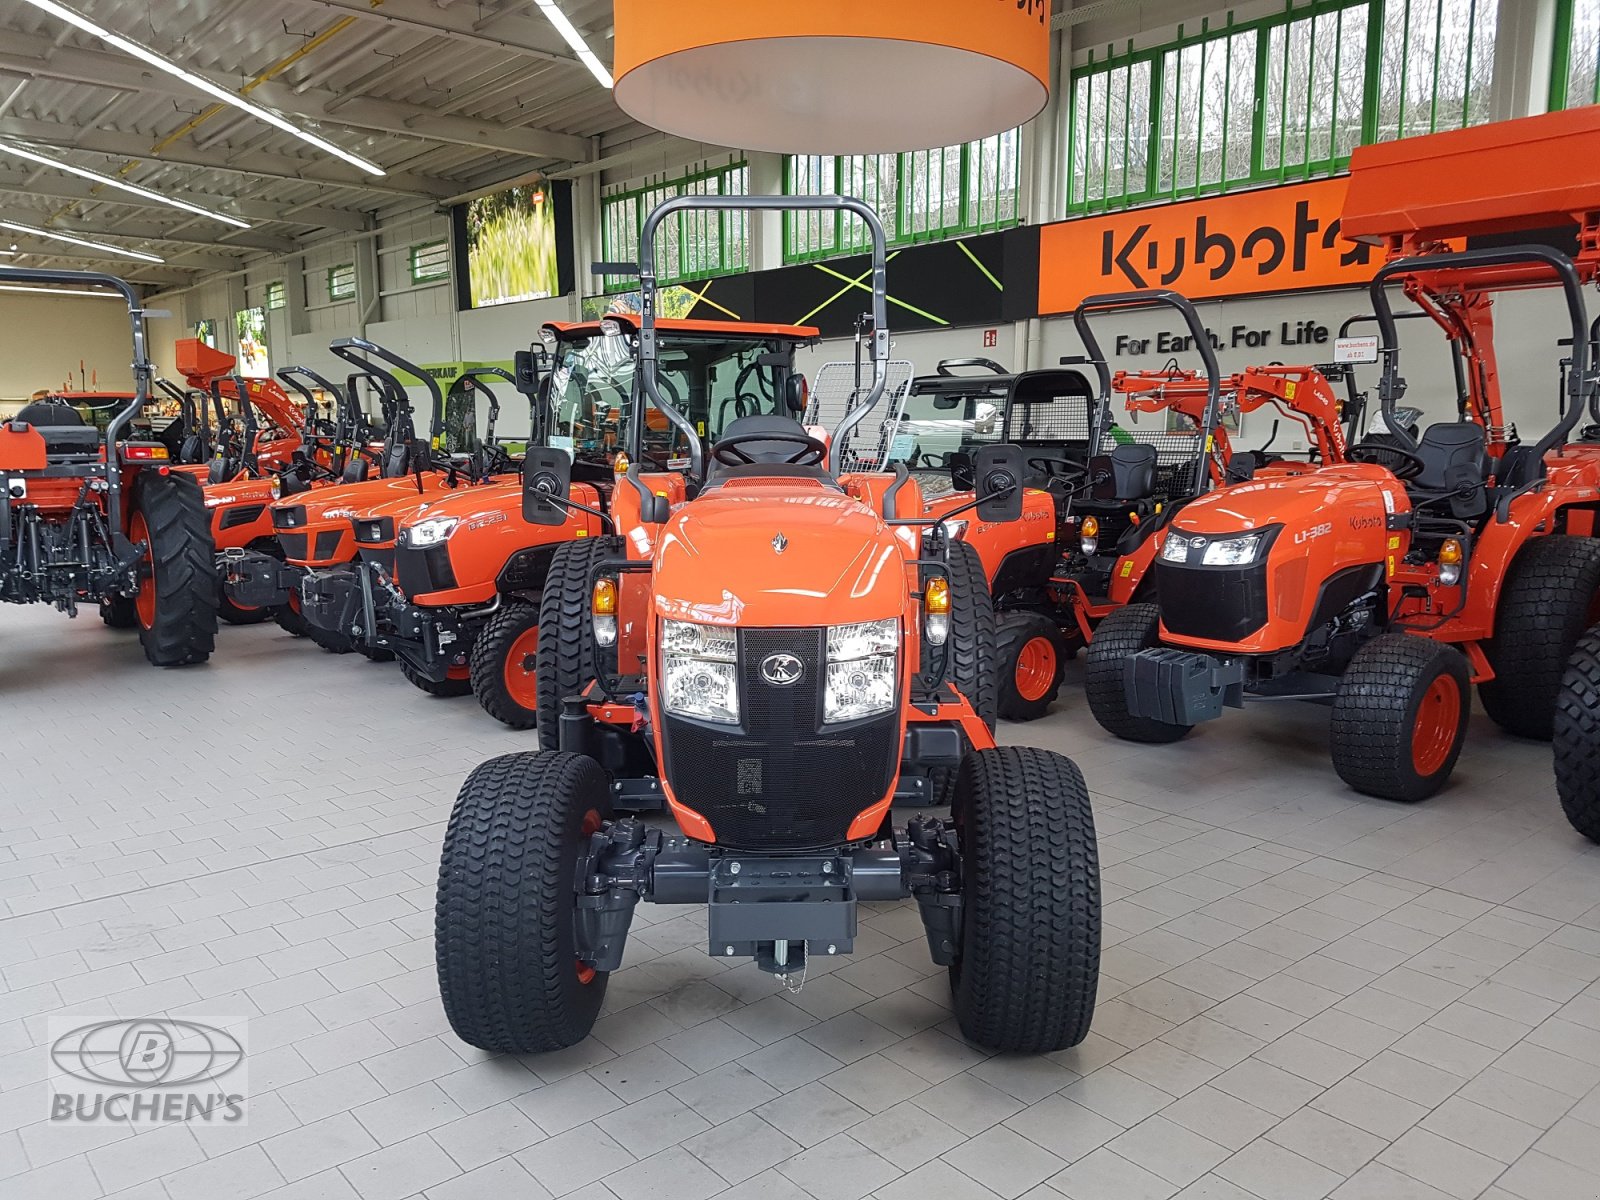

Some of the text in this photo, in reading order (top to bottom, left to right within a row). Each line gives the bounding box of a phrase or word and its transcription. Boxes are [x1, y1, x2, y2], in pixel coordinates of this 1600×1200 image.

[1101, 200, 1371, 289] Kubota
[1115, 320, 1328, 356] For Earh, For Life
[1294, 522, 1332, 544] L1-382
[1349, 514, 1382, 530] Kubota
